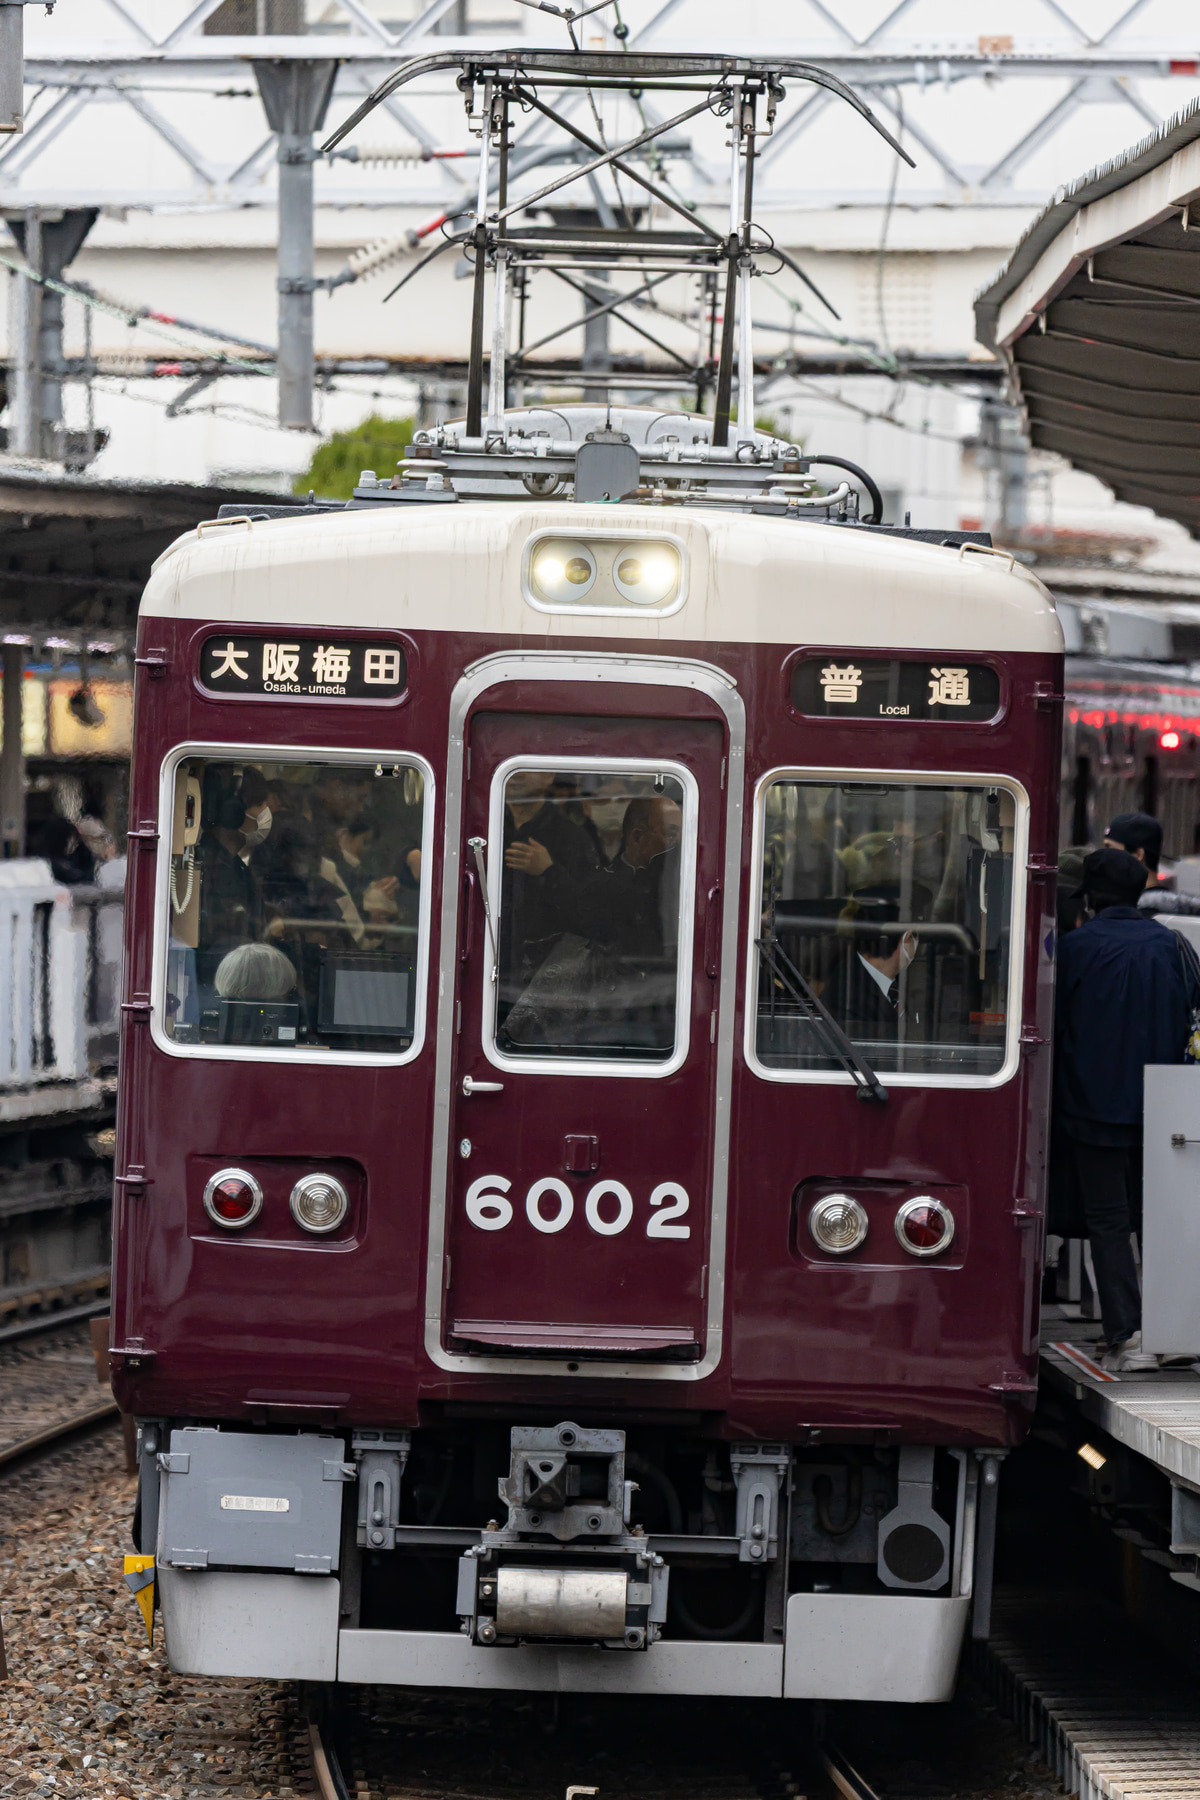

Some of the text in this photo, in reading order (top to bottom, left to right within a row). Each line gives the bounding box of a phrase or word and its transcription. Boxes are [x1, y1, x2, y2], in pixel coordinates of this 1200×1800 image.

[210, 642, 400, 684] 大阪梅田
[263, 681, 346, 695] Osaka-umeda
[820, 664, 971, 705] 普通
[879, 703, 910, 715] Local
[466, 1175, 690, 1238] 6002
